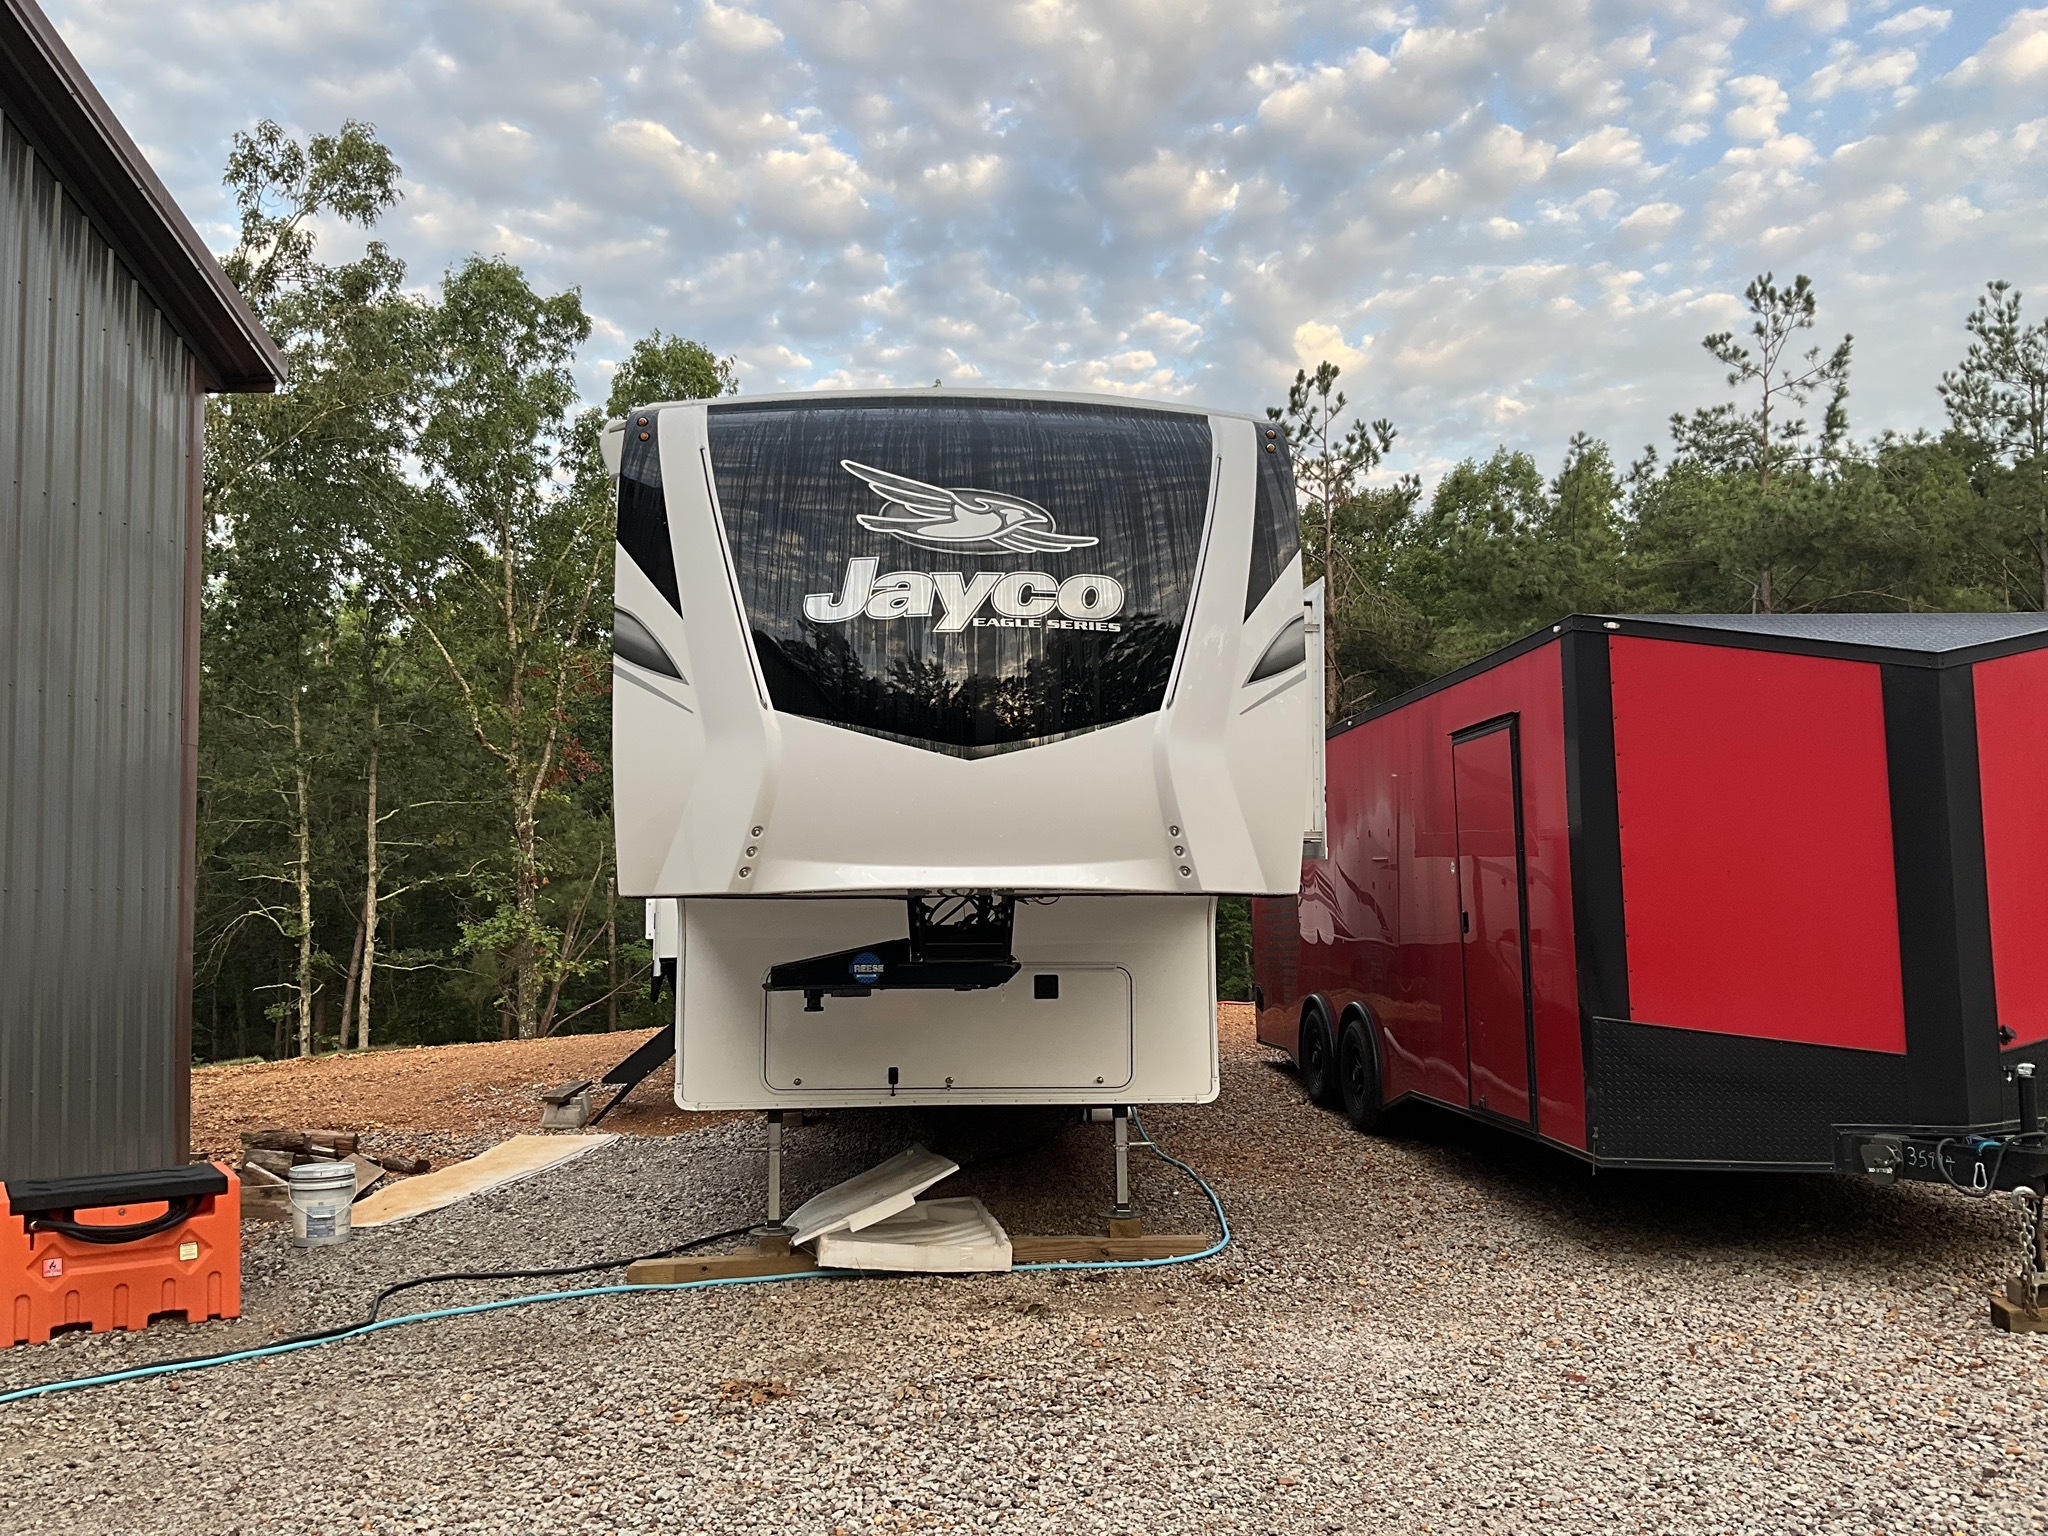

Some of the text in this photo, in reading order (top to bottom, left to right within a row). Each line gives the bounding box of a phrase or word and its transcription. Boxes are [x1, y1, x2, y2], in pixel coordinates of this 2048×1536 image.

[803, 556, 1125, 633] Jayco
[972, 617, 1121, 632] EAGLE SERIES
[853, 964, 884, 973] REESE
